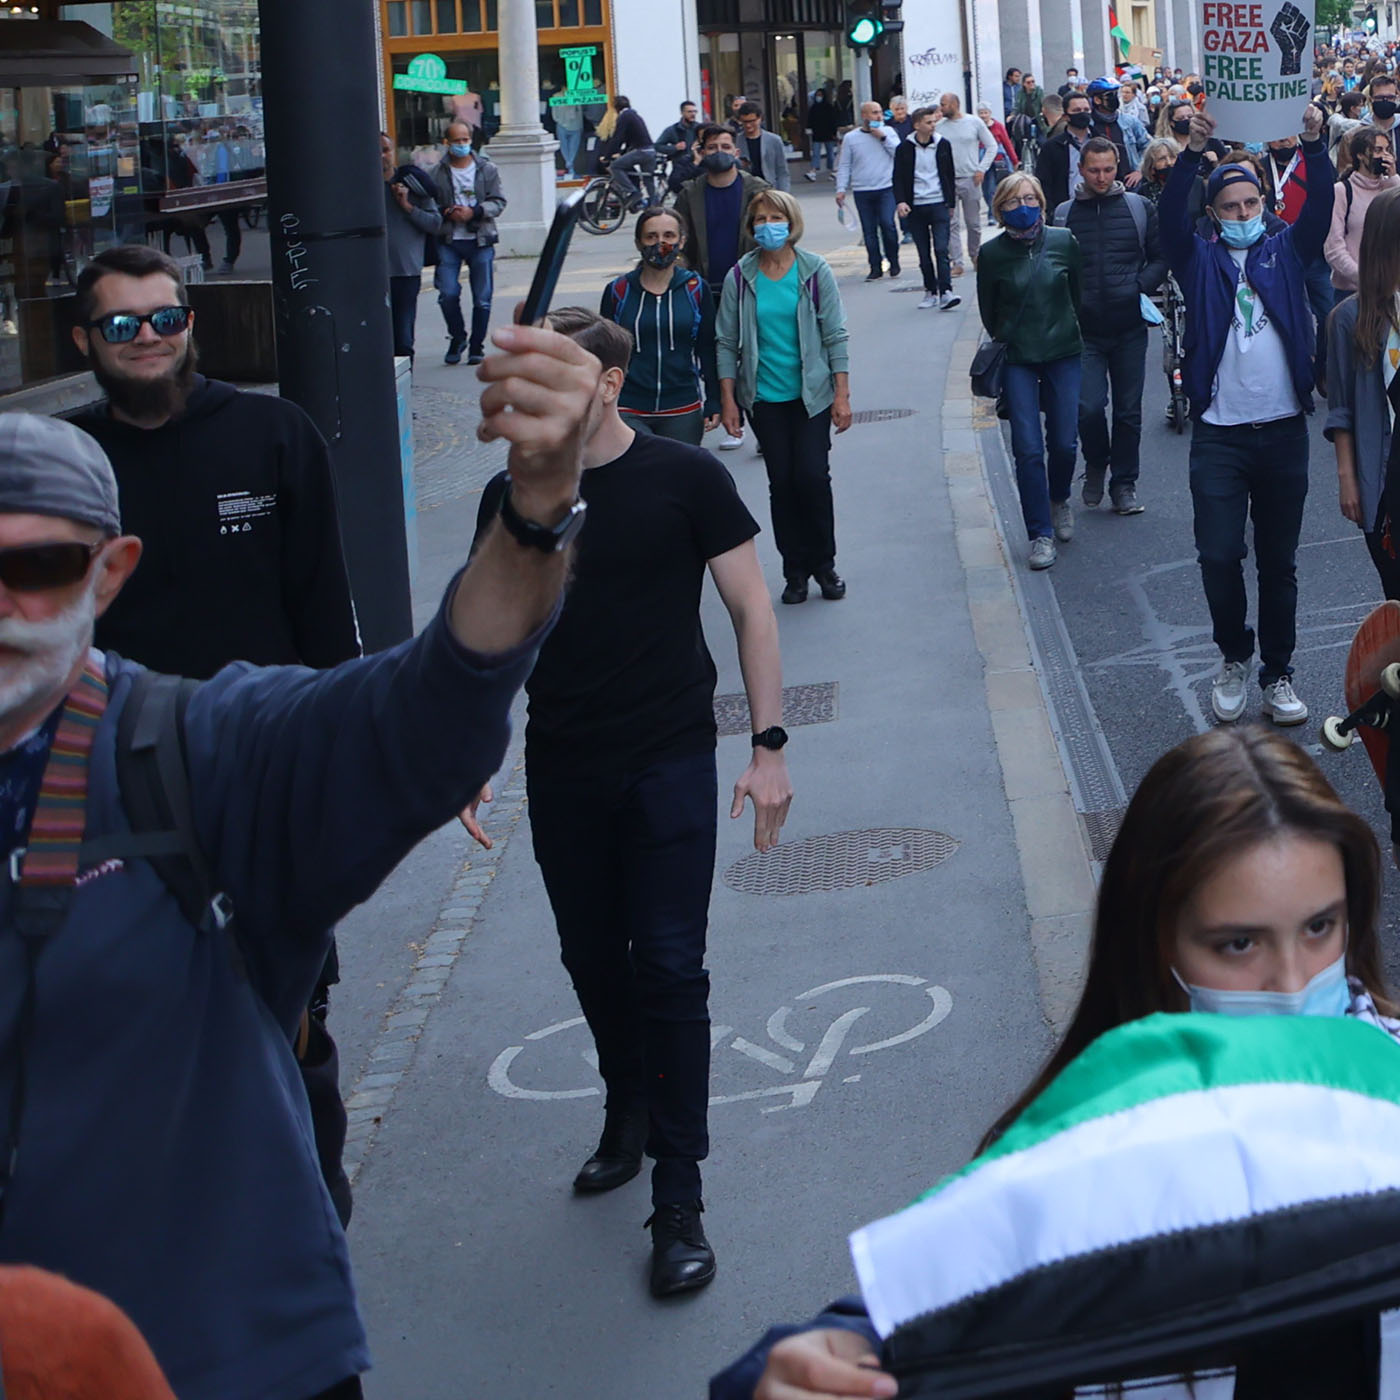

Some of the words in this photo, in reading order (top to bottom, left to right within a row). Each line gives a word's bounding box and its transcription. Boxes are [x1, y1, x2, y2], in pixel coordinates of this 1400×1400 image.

[1203, 2, 1264, 29] FREE
[1203, 29, 1270, 53] GAZA
[1204, 54, 1264, 82] FREE
[1205, 78, 1308, 102] PALESTINE
